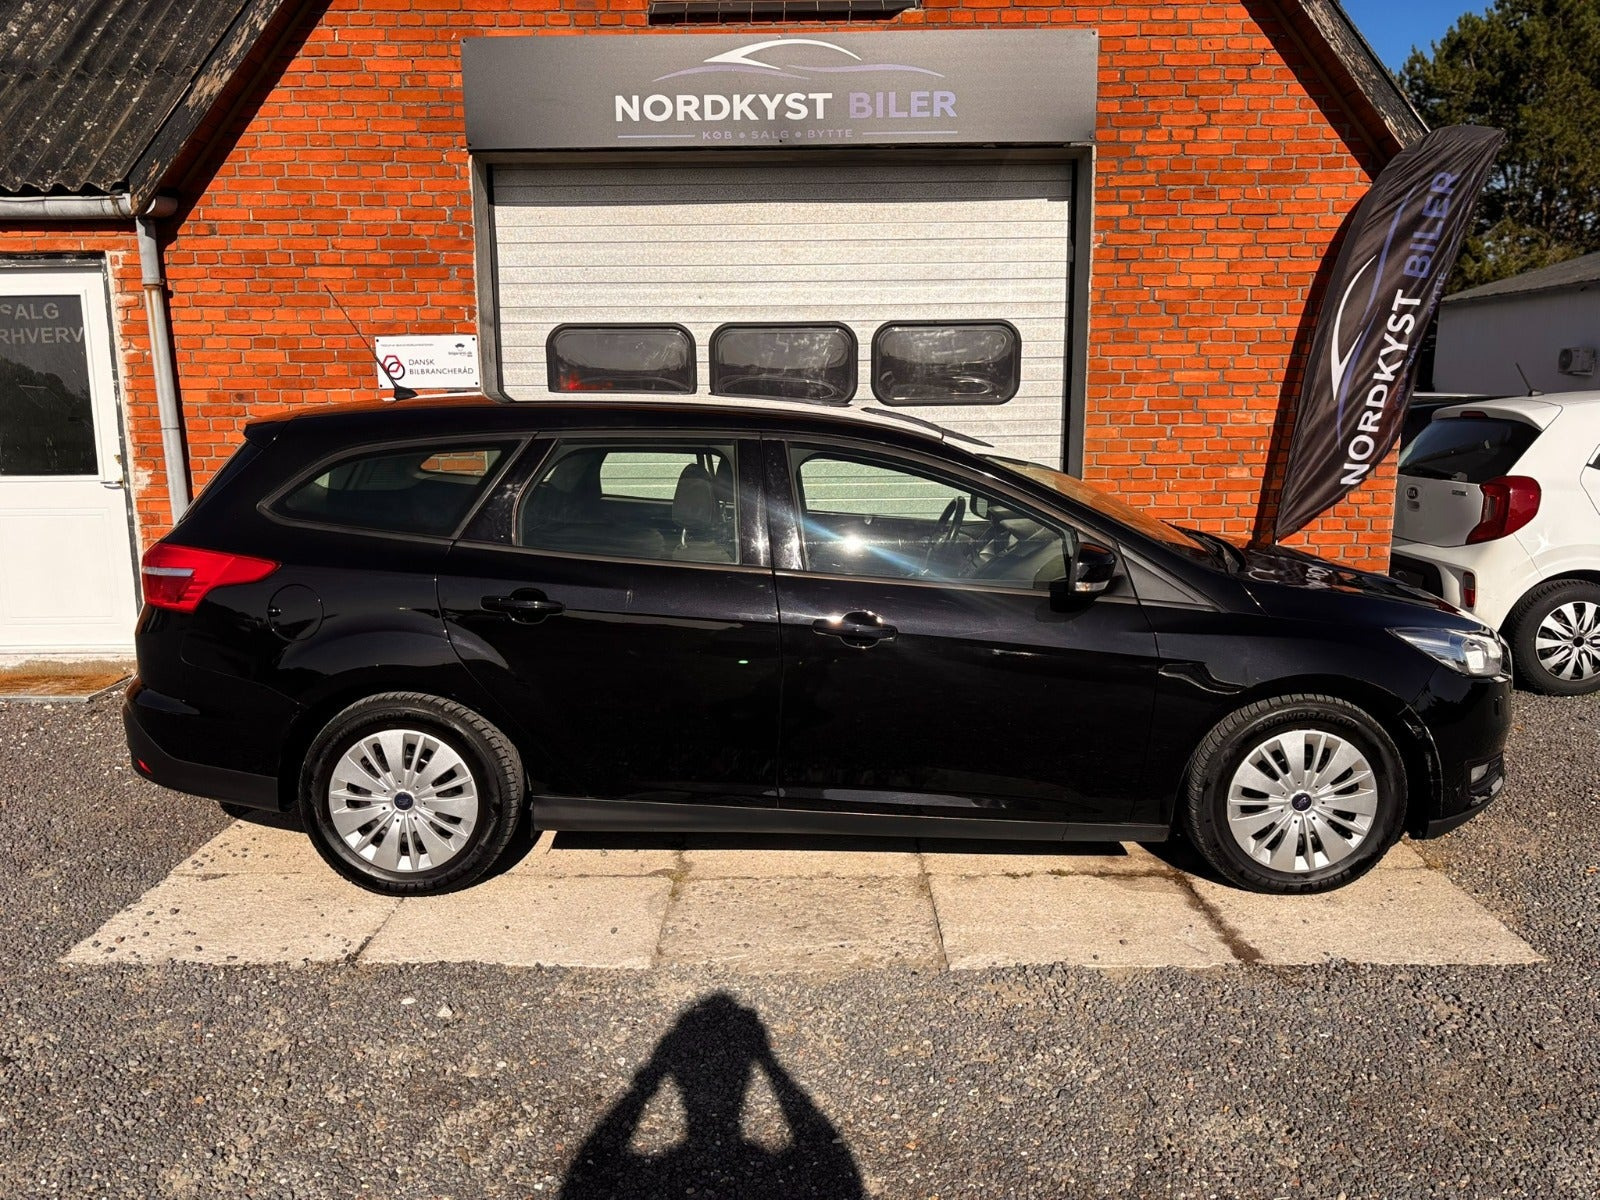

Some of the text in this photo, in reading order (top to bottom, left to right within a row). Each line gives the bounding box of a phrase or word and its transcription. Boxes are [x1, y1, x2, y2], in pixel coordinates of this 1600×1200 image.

[614, 90, 958, 122] NORDKYST BILER
[702, 128, 853, 140] KØB SALG BYTTE
[1339, 171, 1460, 487] NORDKYST BILER
[408, 358, 435, 366] DANSK
[409, 367, 474, 375] BILBRANCHERÅD
